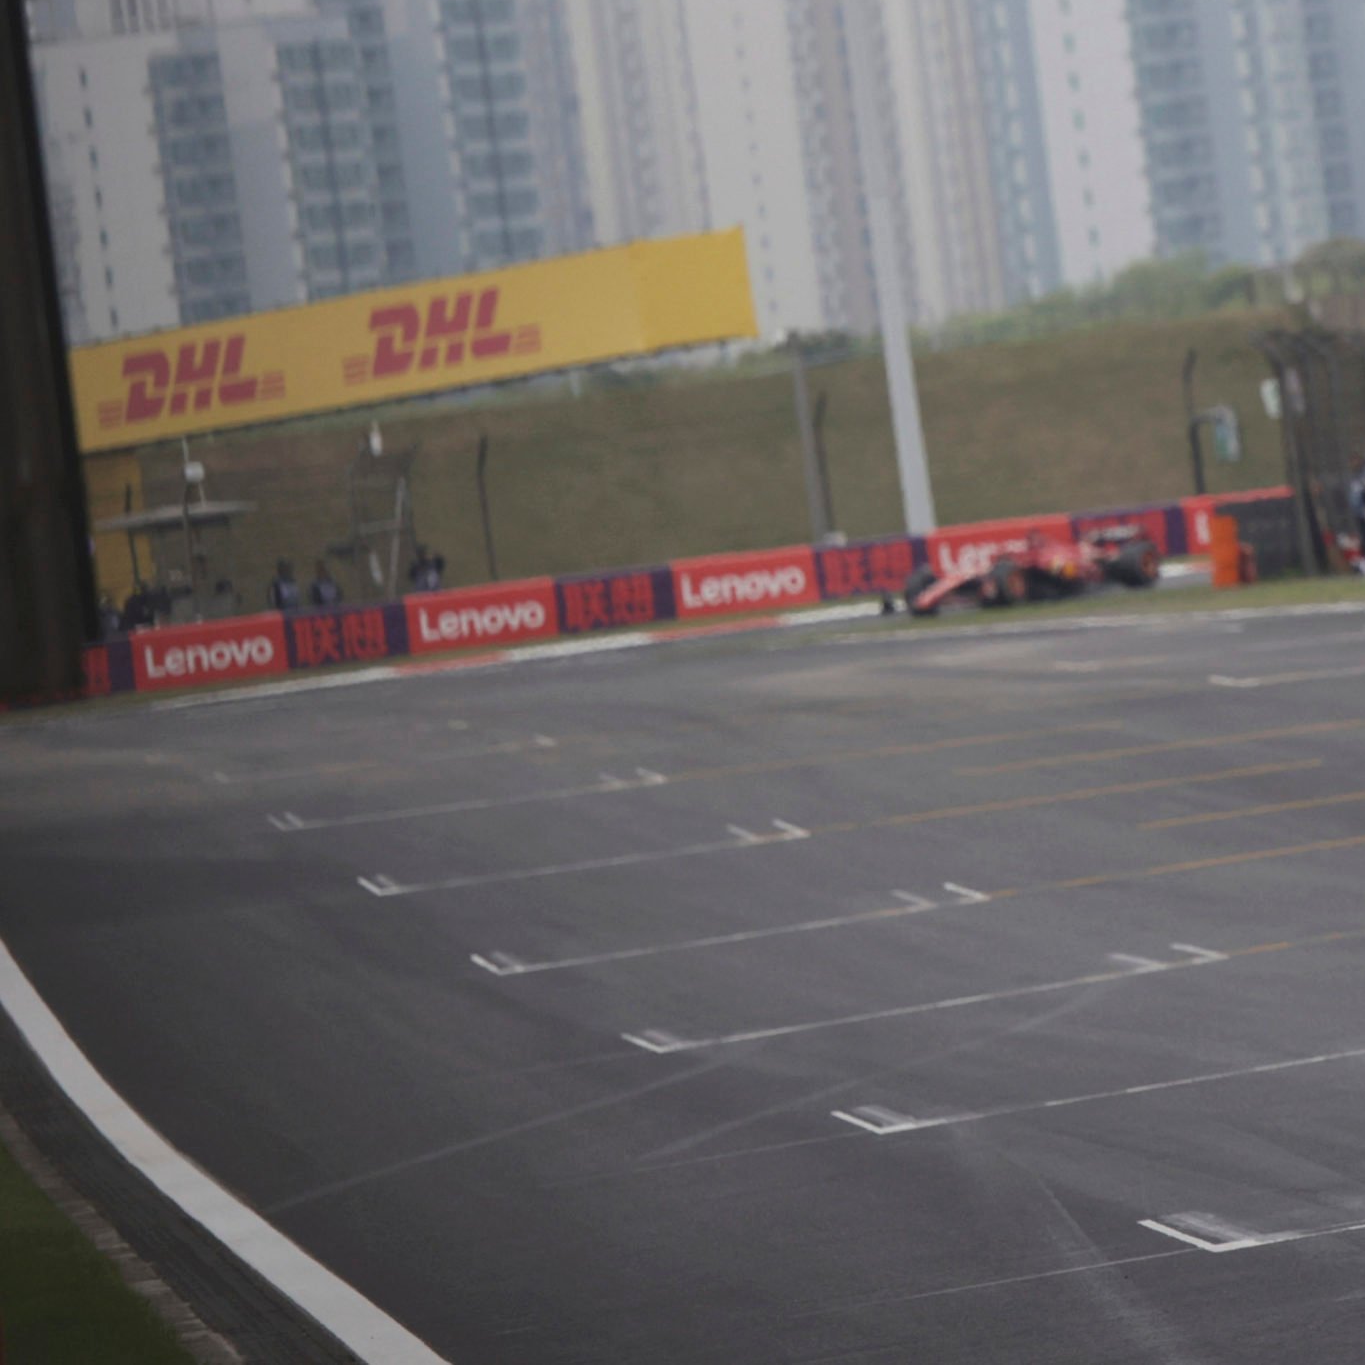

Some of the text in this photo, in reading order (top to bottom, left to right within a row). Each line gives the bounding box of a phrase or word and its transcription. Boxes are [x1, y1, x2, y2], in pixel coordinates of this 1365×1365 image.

[369, 288, 511, 378] DHL
[122, 334, 257, 422] DHL
[681, 566, 806, 608] Lenovo
[419, 601, 546, 642] Lenovo
[144, 635, 274, 679] Lenovo
